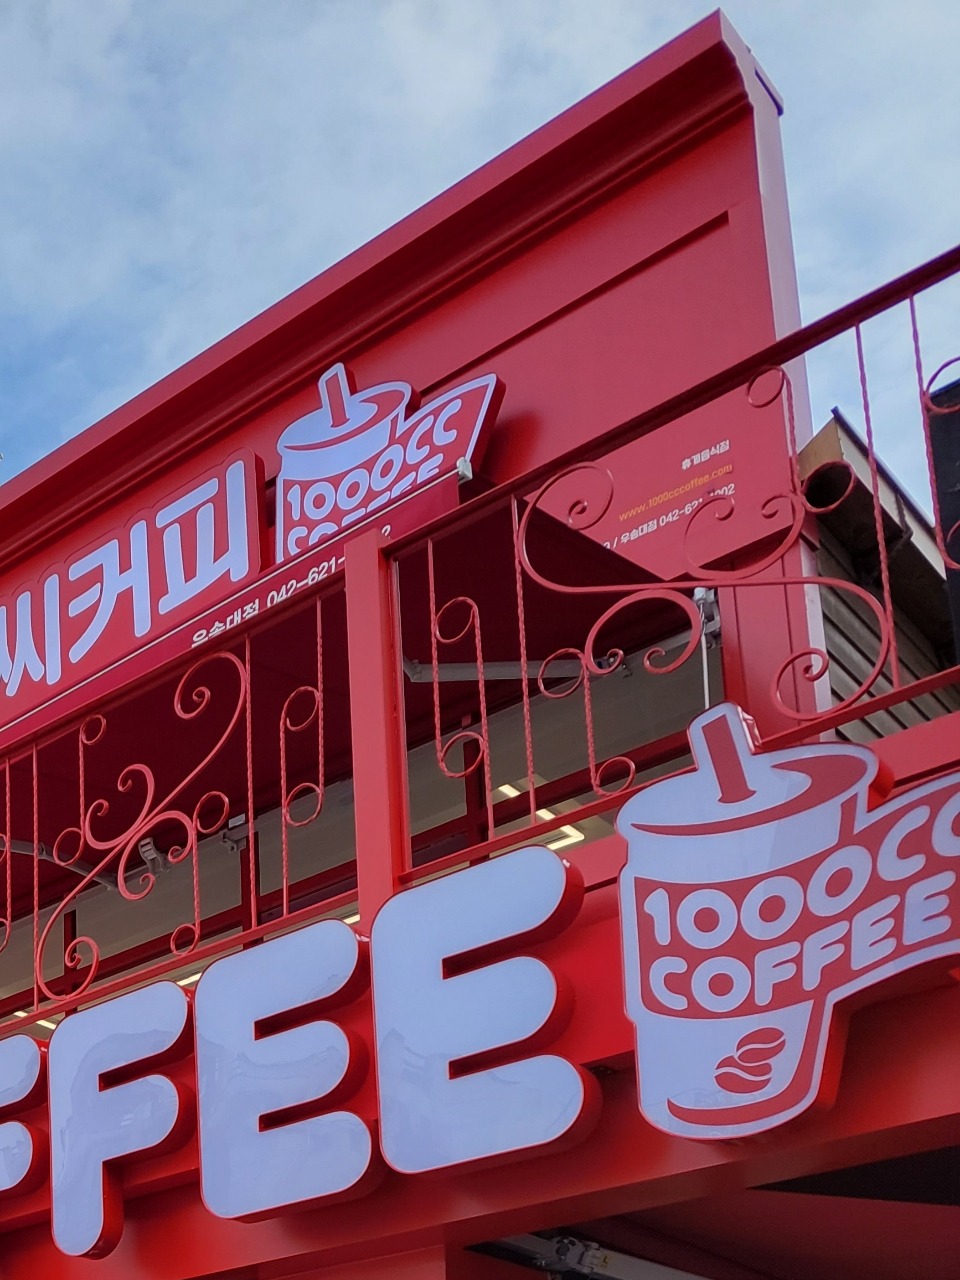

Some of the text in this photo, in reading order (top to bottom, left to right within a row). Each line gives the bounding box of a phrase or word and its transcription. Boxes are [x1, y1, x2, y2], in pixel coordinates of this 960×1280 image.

[287, 399, 462, 520] 1000CC
[682, 439, 730, 470] 휴게음식점
[618, 464, 733, 522] www.1000cccoffee.com
[621, 518, 658, 543] 우송대점
[649, 870, 957, 1013] COFFEE
